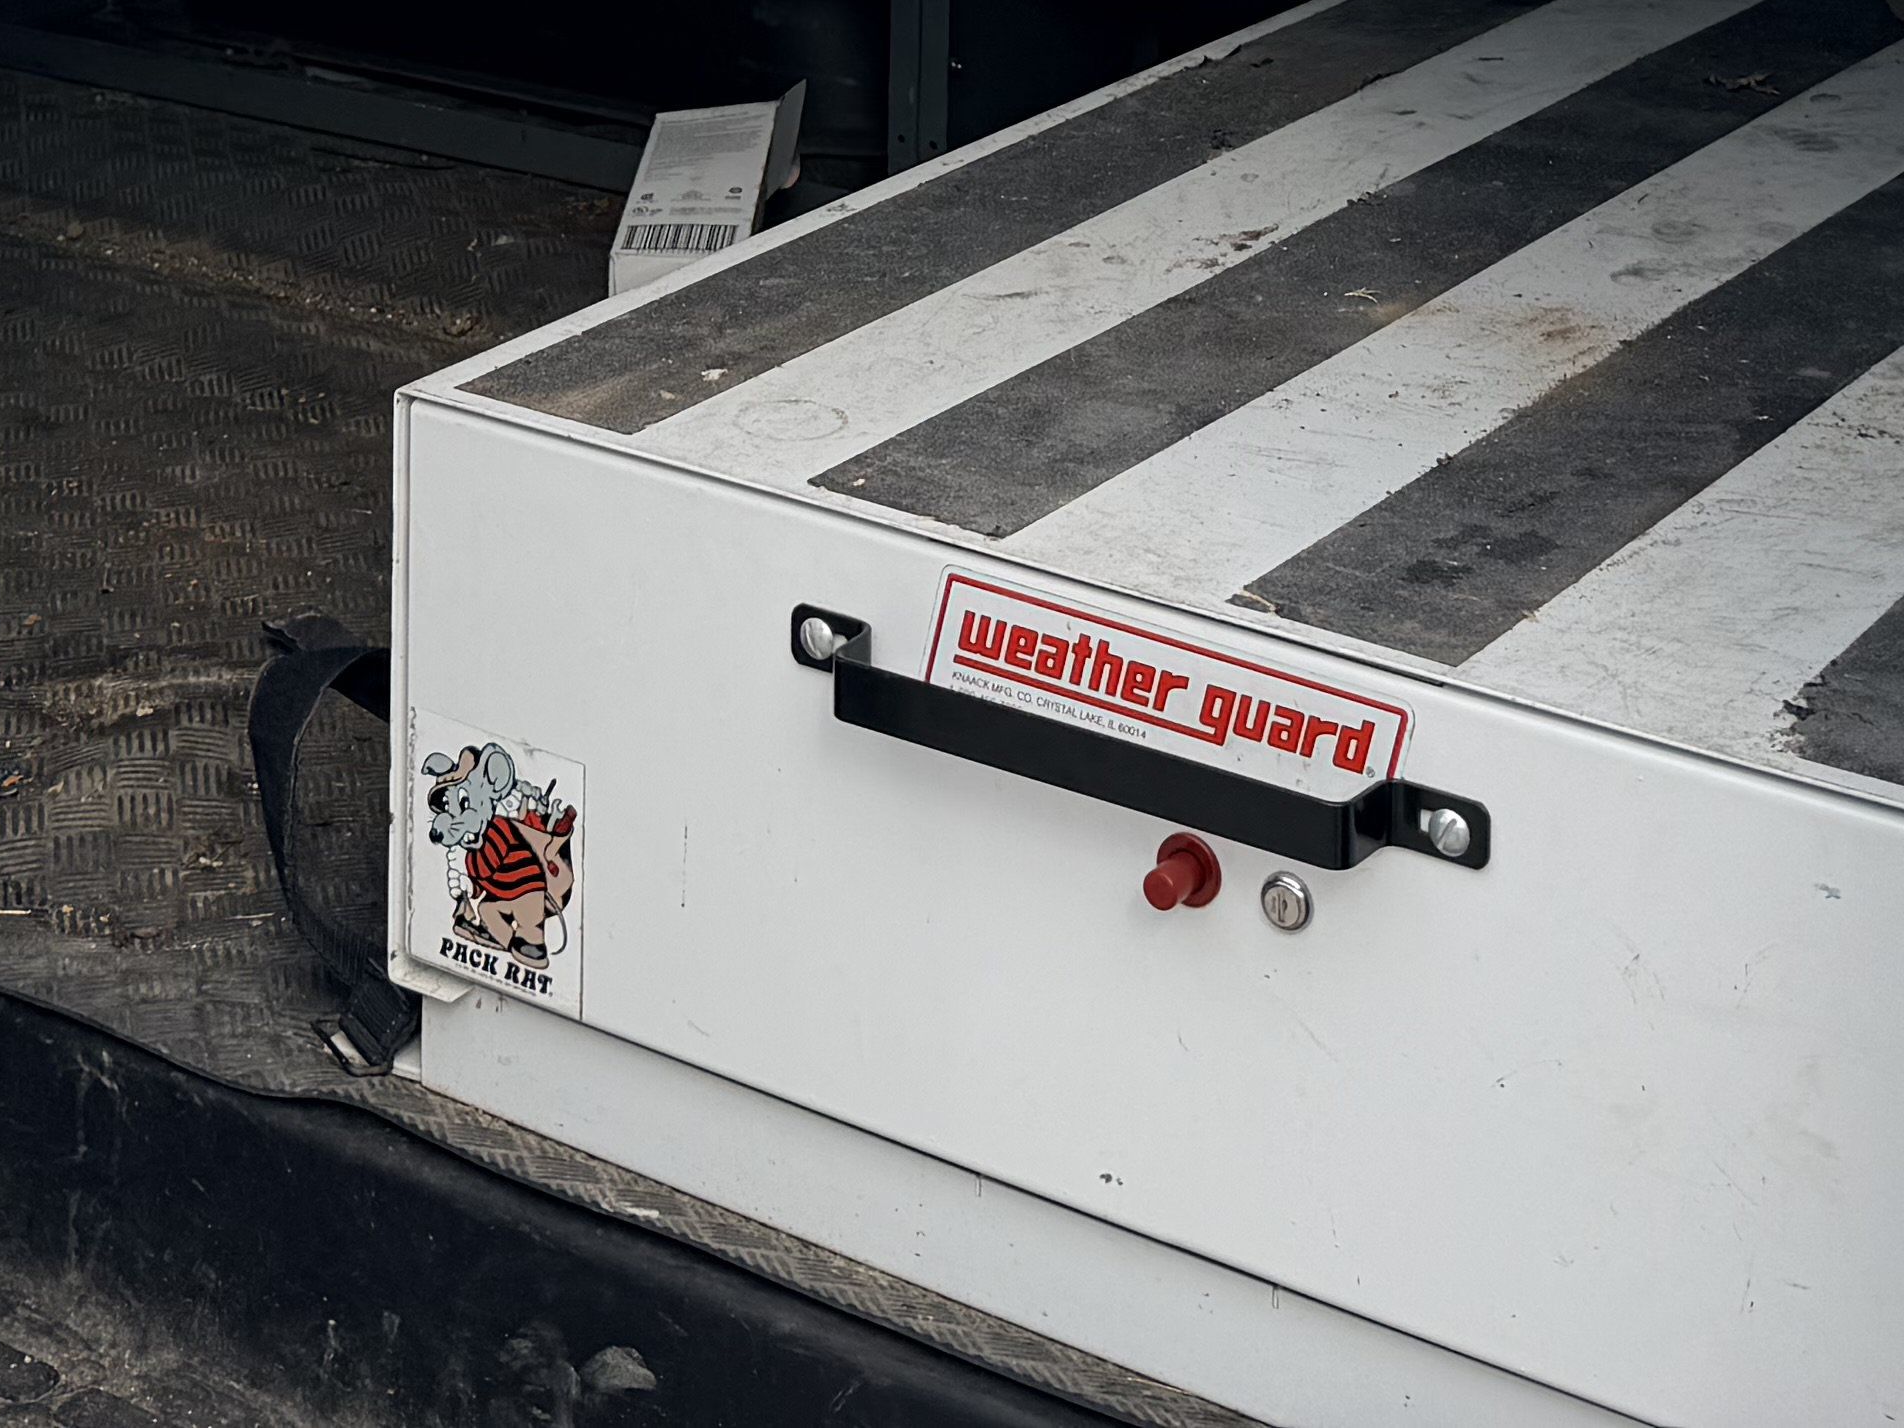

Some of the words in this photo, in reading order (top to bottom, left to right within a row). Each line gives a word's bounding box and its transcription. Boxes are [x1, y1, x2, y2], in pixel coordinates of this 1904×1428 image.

[952, 671, 990, 690] KNAACK
[1036, 696, 1078, 719] CRYSTAL
[1118, 722, 1147, 739] 60014
[958, 610, 1190, 713] weather
[1199, 684, 1376, 775] guard
[439, 937, 499, 976] PACK
[504, 961, 553, 995] RAT
